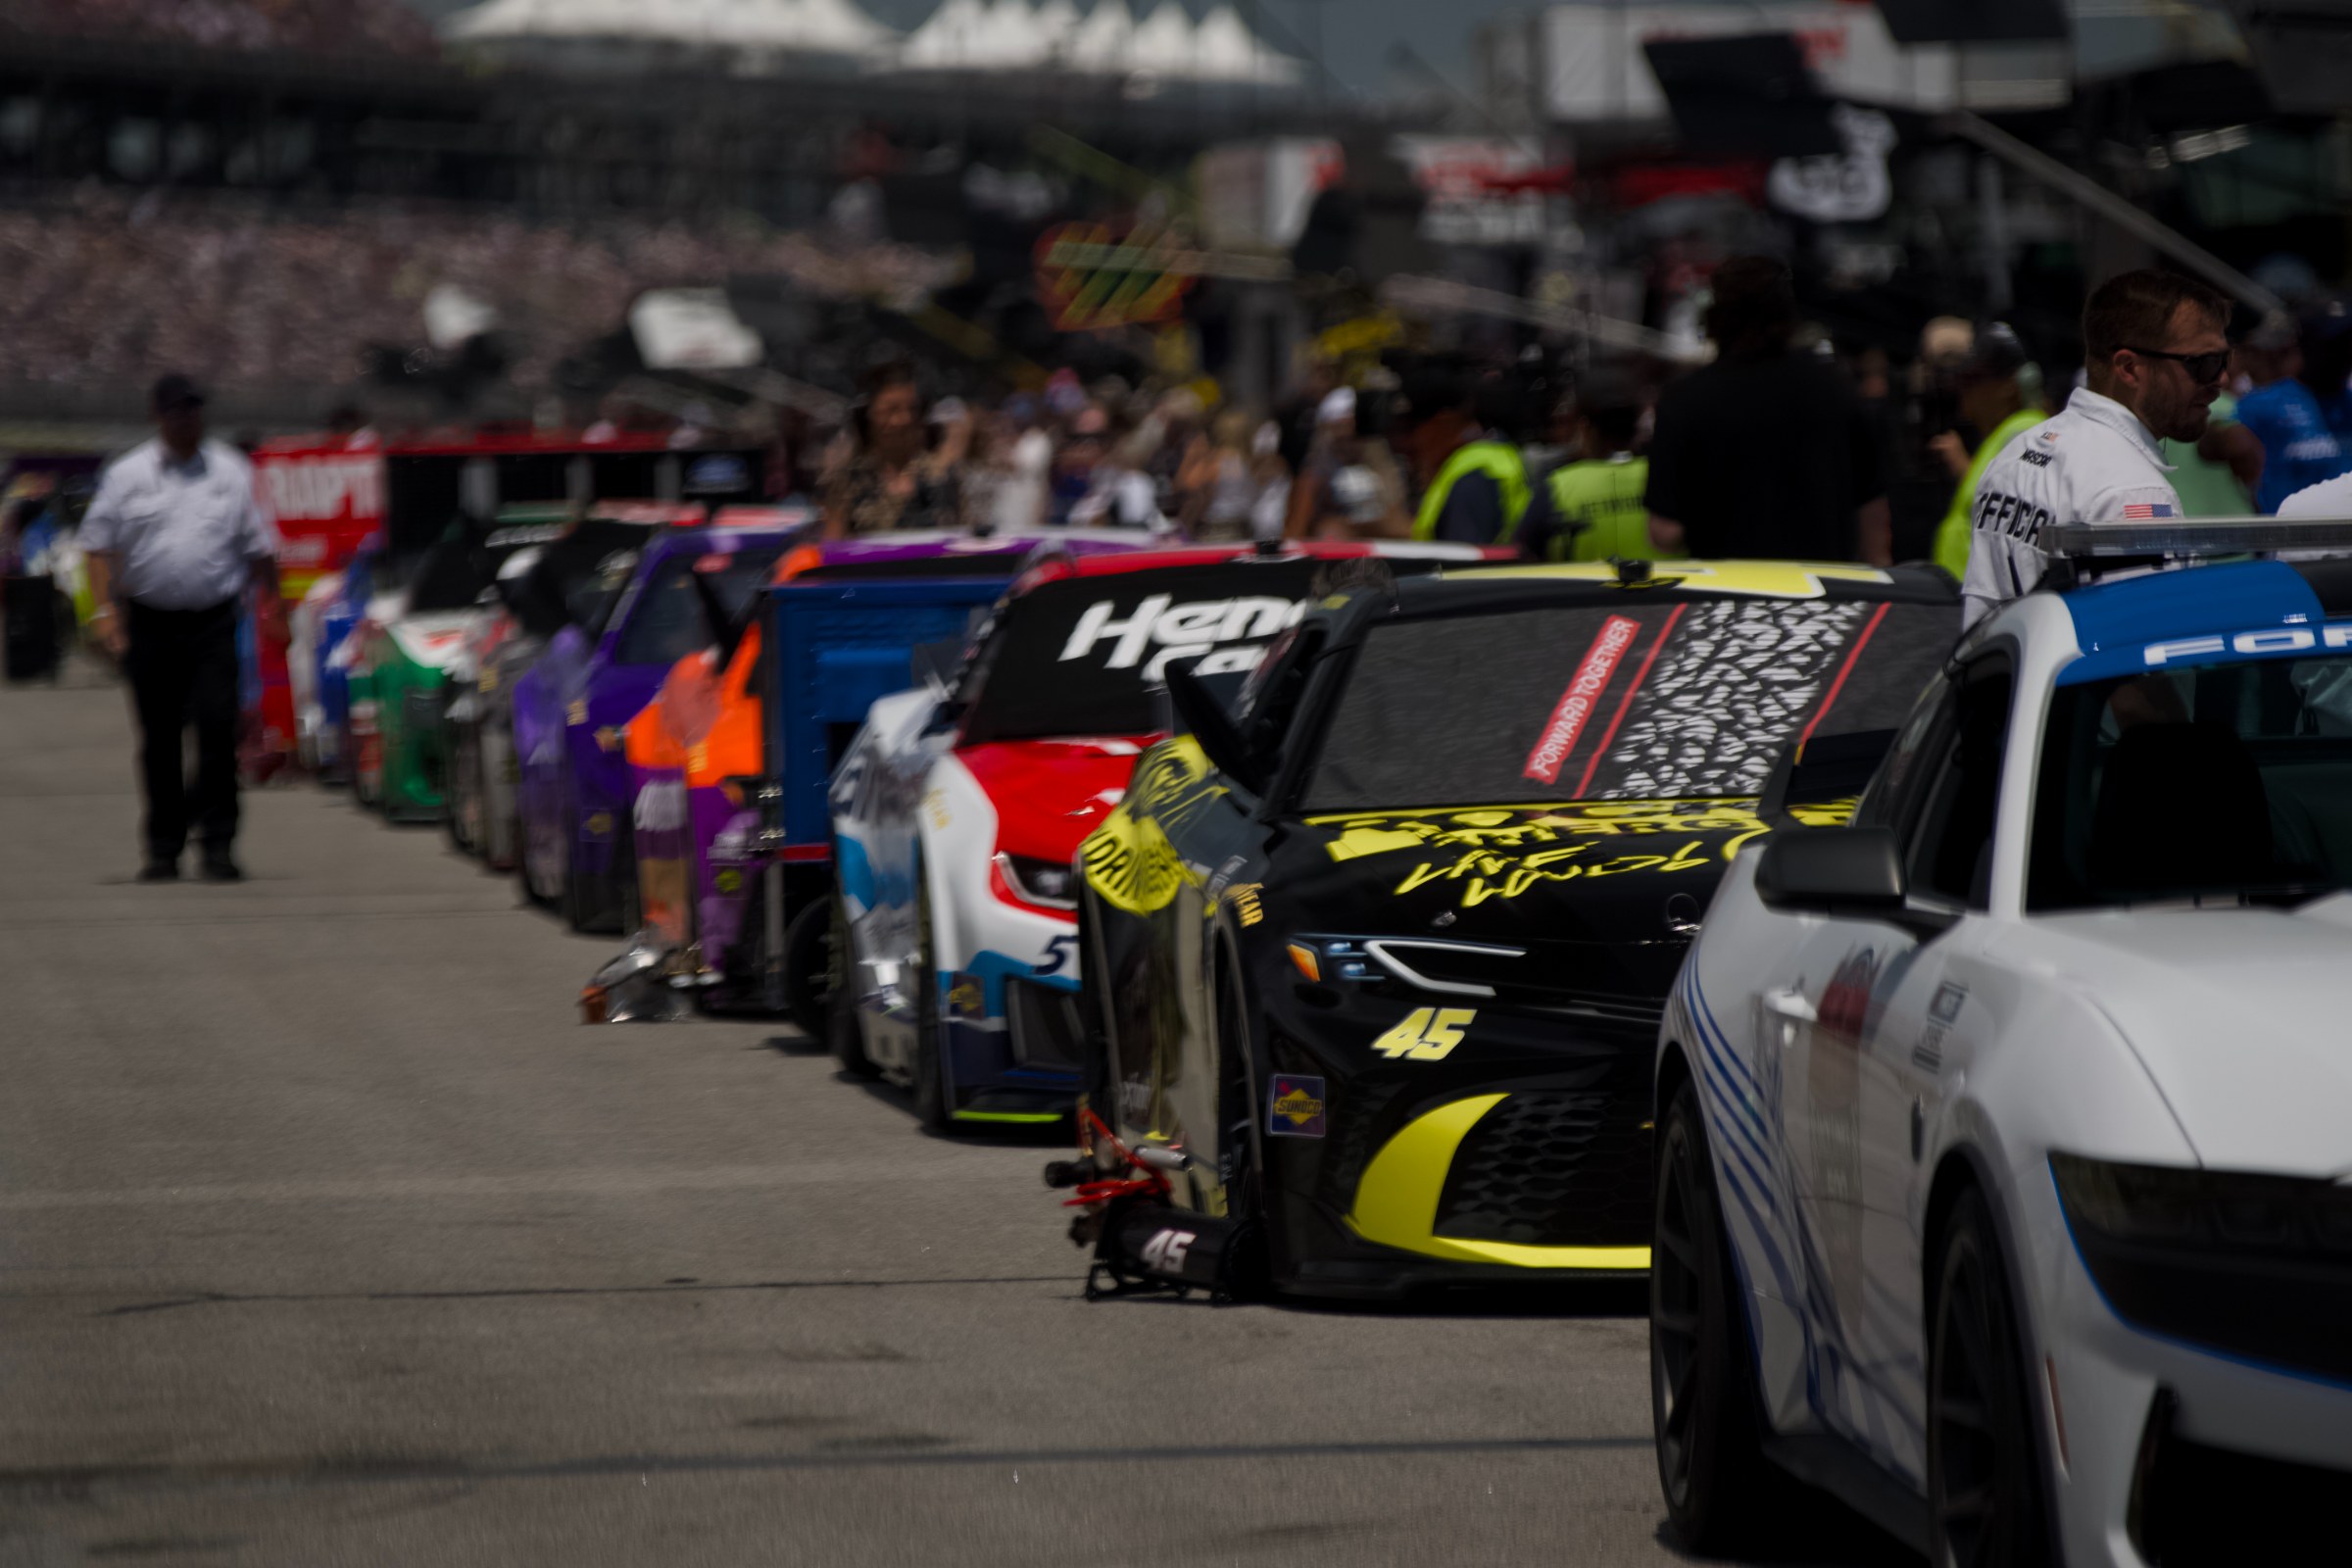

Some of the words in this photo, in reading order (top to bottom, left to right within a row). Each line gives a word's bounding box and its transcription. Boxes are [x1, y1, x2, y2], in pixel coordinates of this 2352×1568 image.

[1530, 695, 1589, 777] FORWARD
[1571, 618, 1635, 697] TOGETHER
[1369, 1005, 1479, 1062] 45
[1273, 1096, 1323, 1116] SUNOCO
[1140, 1227, 1198, 1273] 45
